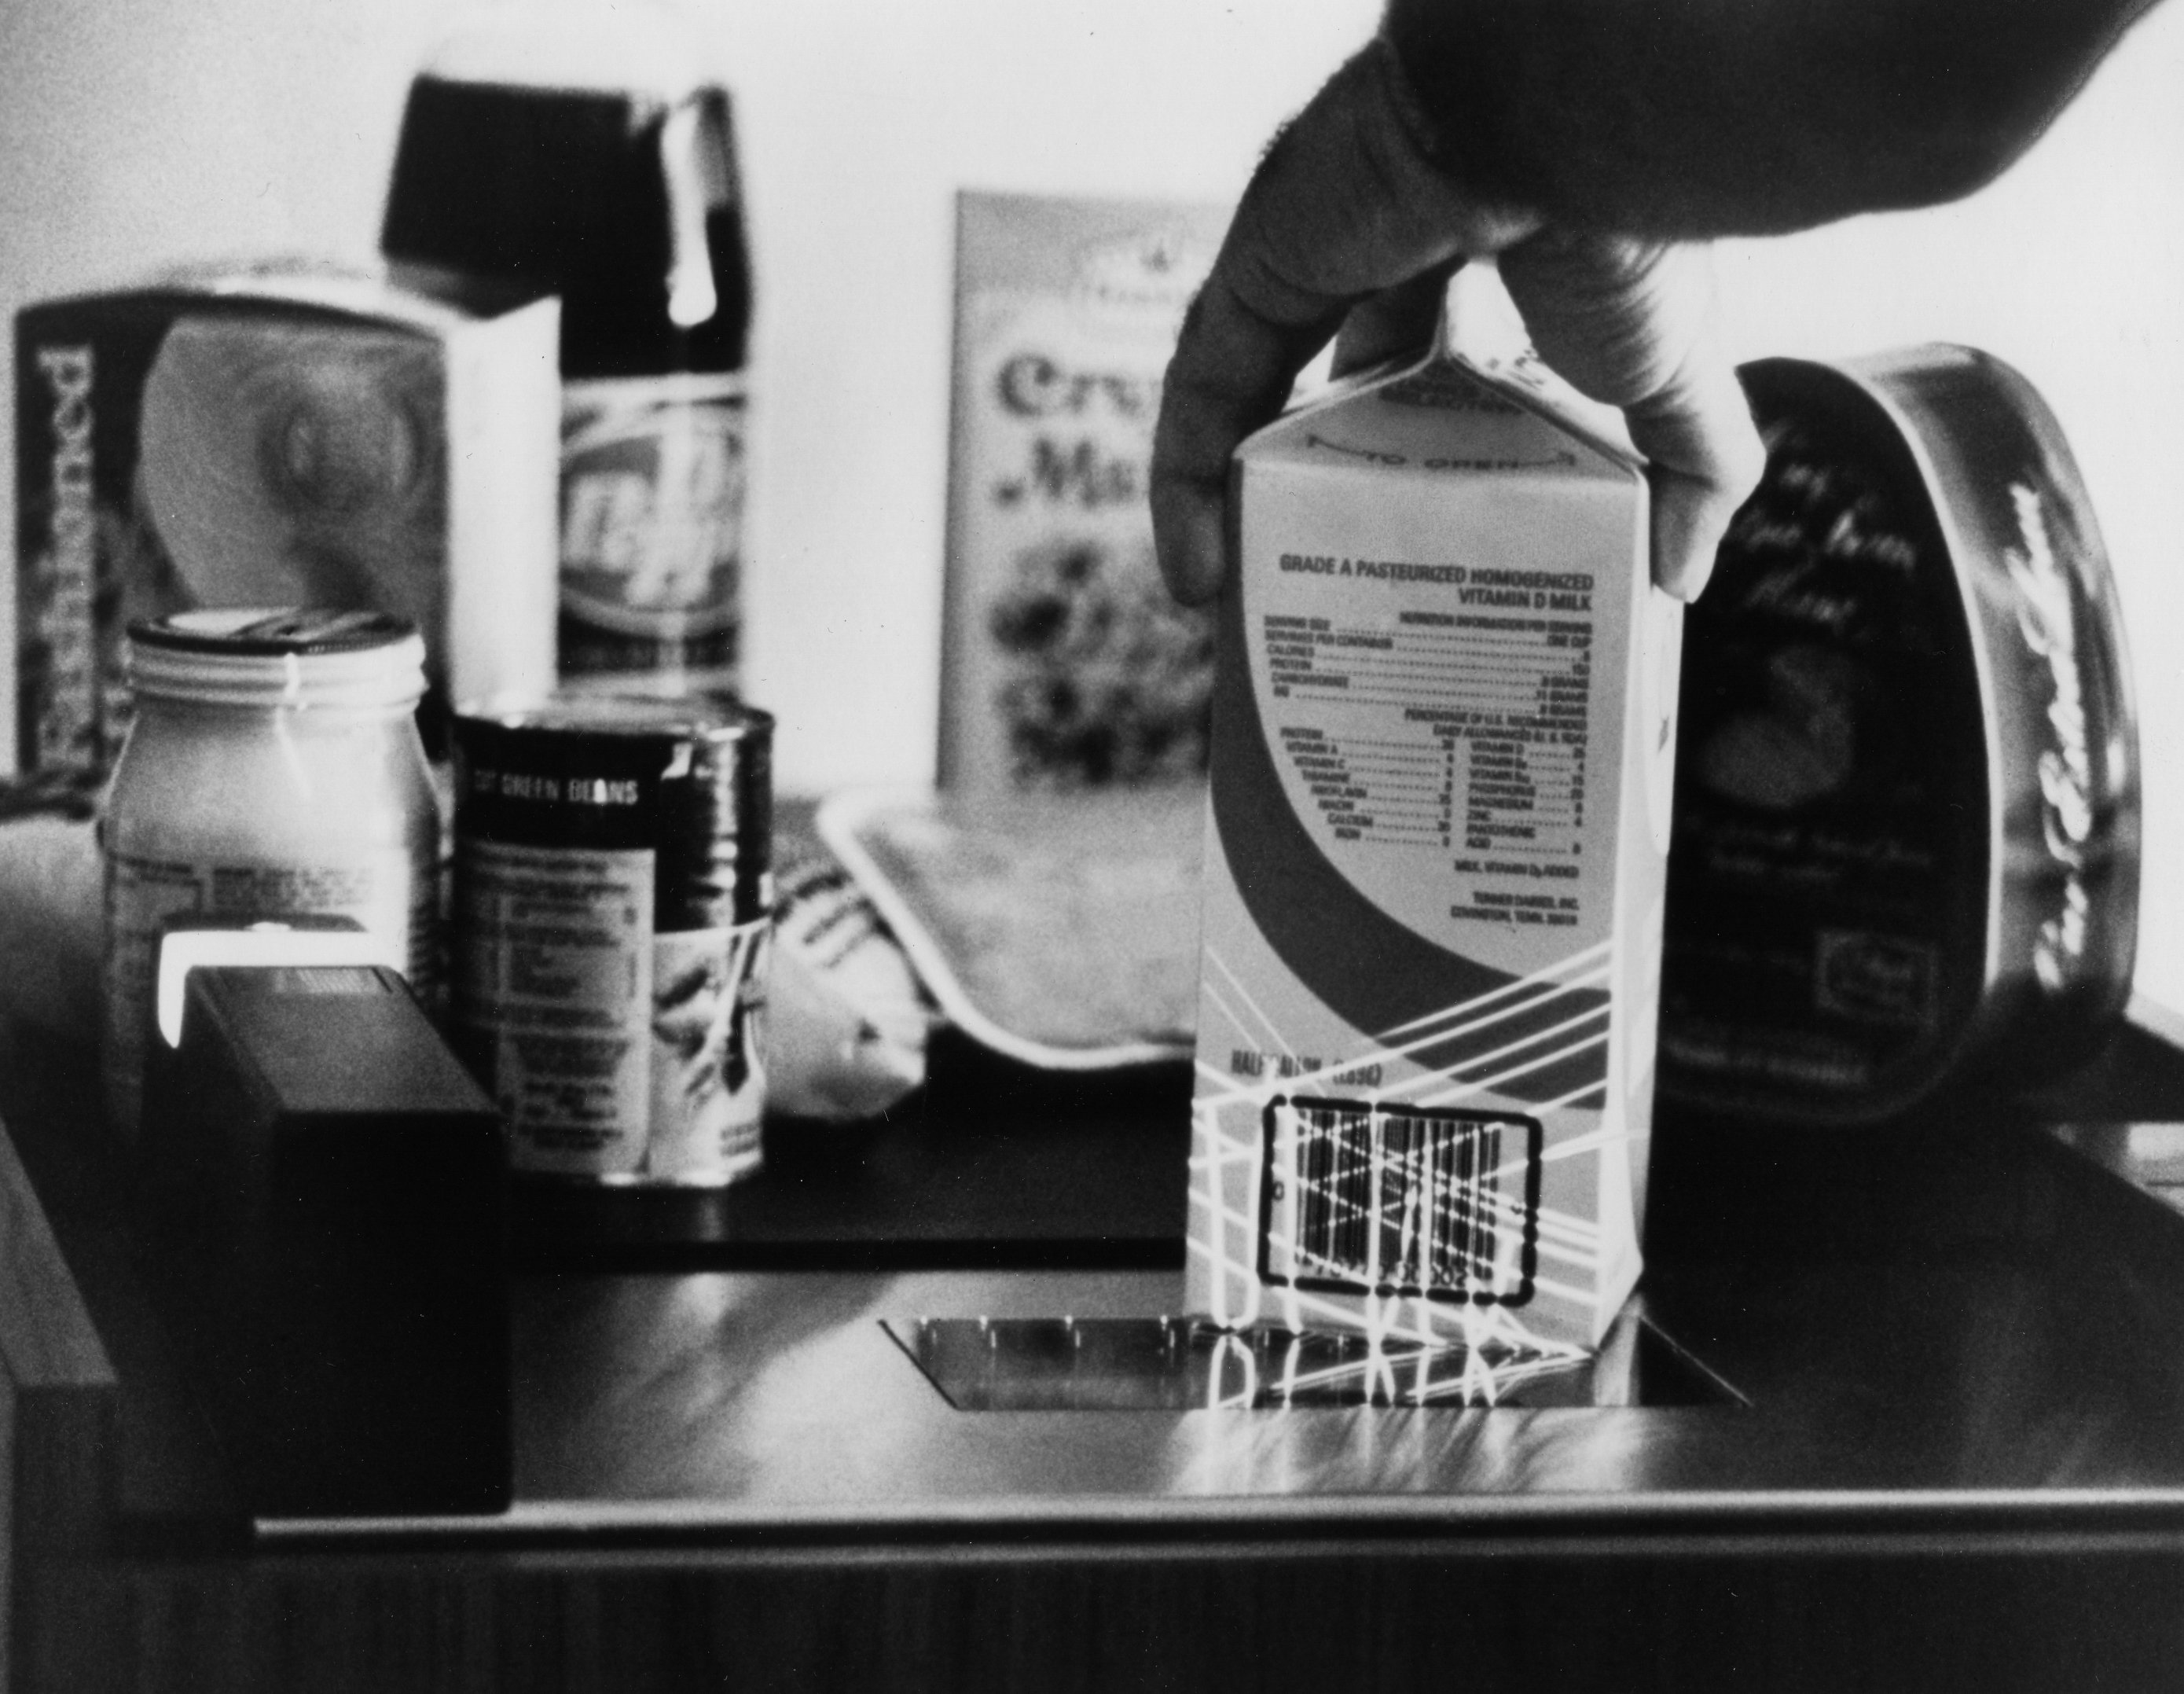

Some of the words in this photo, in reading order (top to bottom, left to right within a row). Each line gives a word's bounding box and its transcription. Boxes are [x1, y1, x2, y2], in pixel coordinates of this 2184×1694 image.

[1279, 553, 1335, 575] GRADE
[1340, 559, 1352, 576] A
[1356, 560, 1466, 583] PASTEURIZED
[1470, 568, 1594, 592] HOMOGENIZED
[1458, 587, 1529, 608] VITAMIN
[1533, 591, 1546, 609] D
[1550, 592, 1592, 612] MILK
[1267, 644, 1315, 658] CALORIES
[1337, 759, 1345, 769] C
[568, 777, 638, 805] BENS
